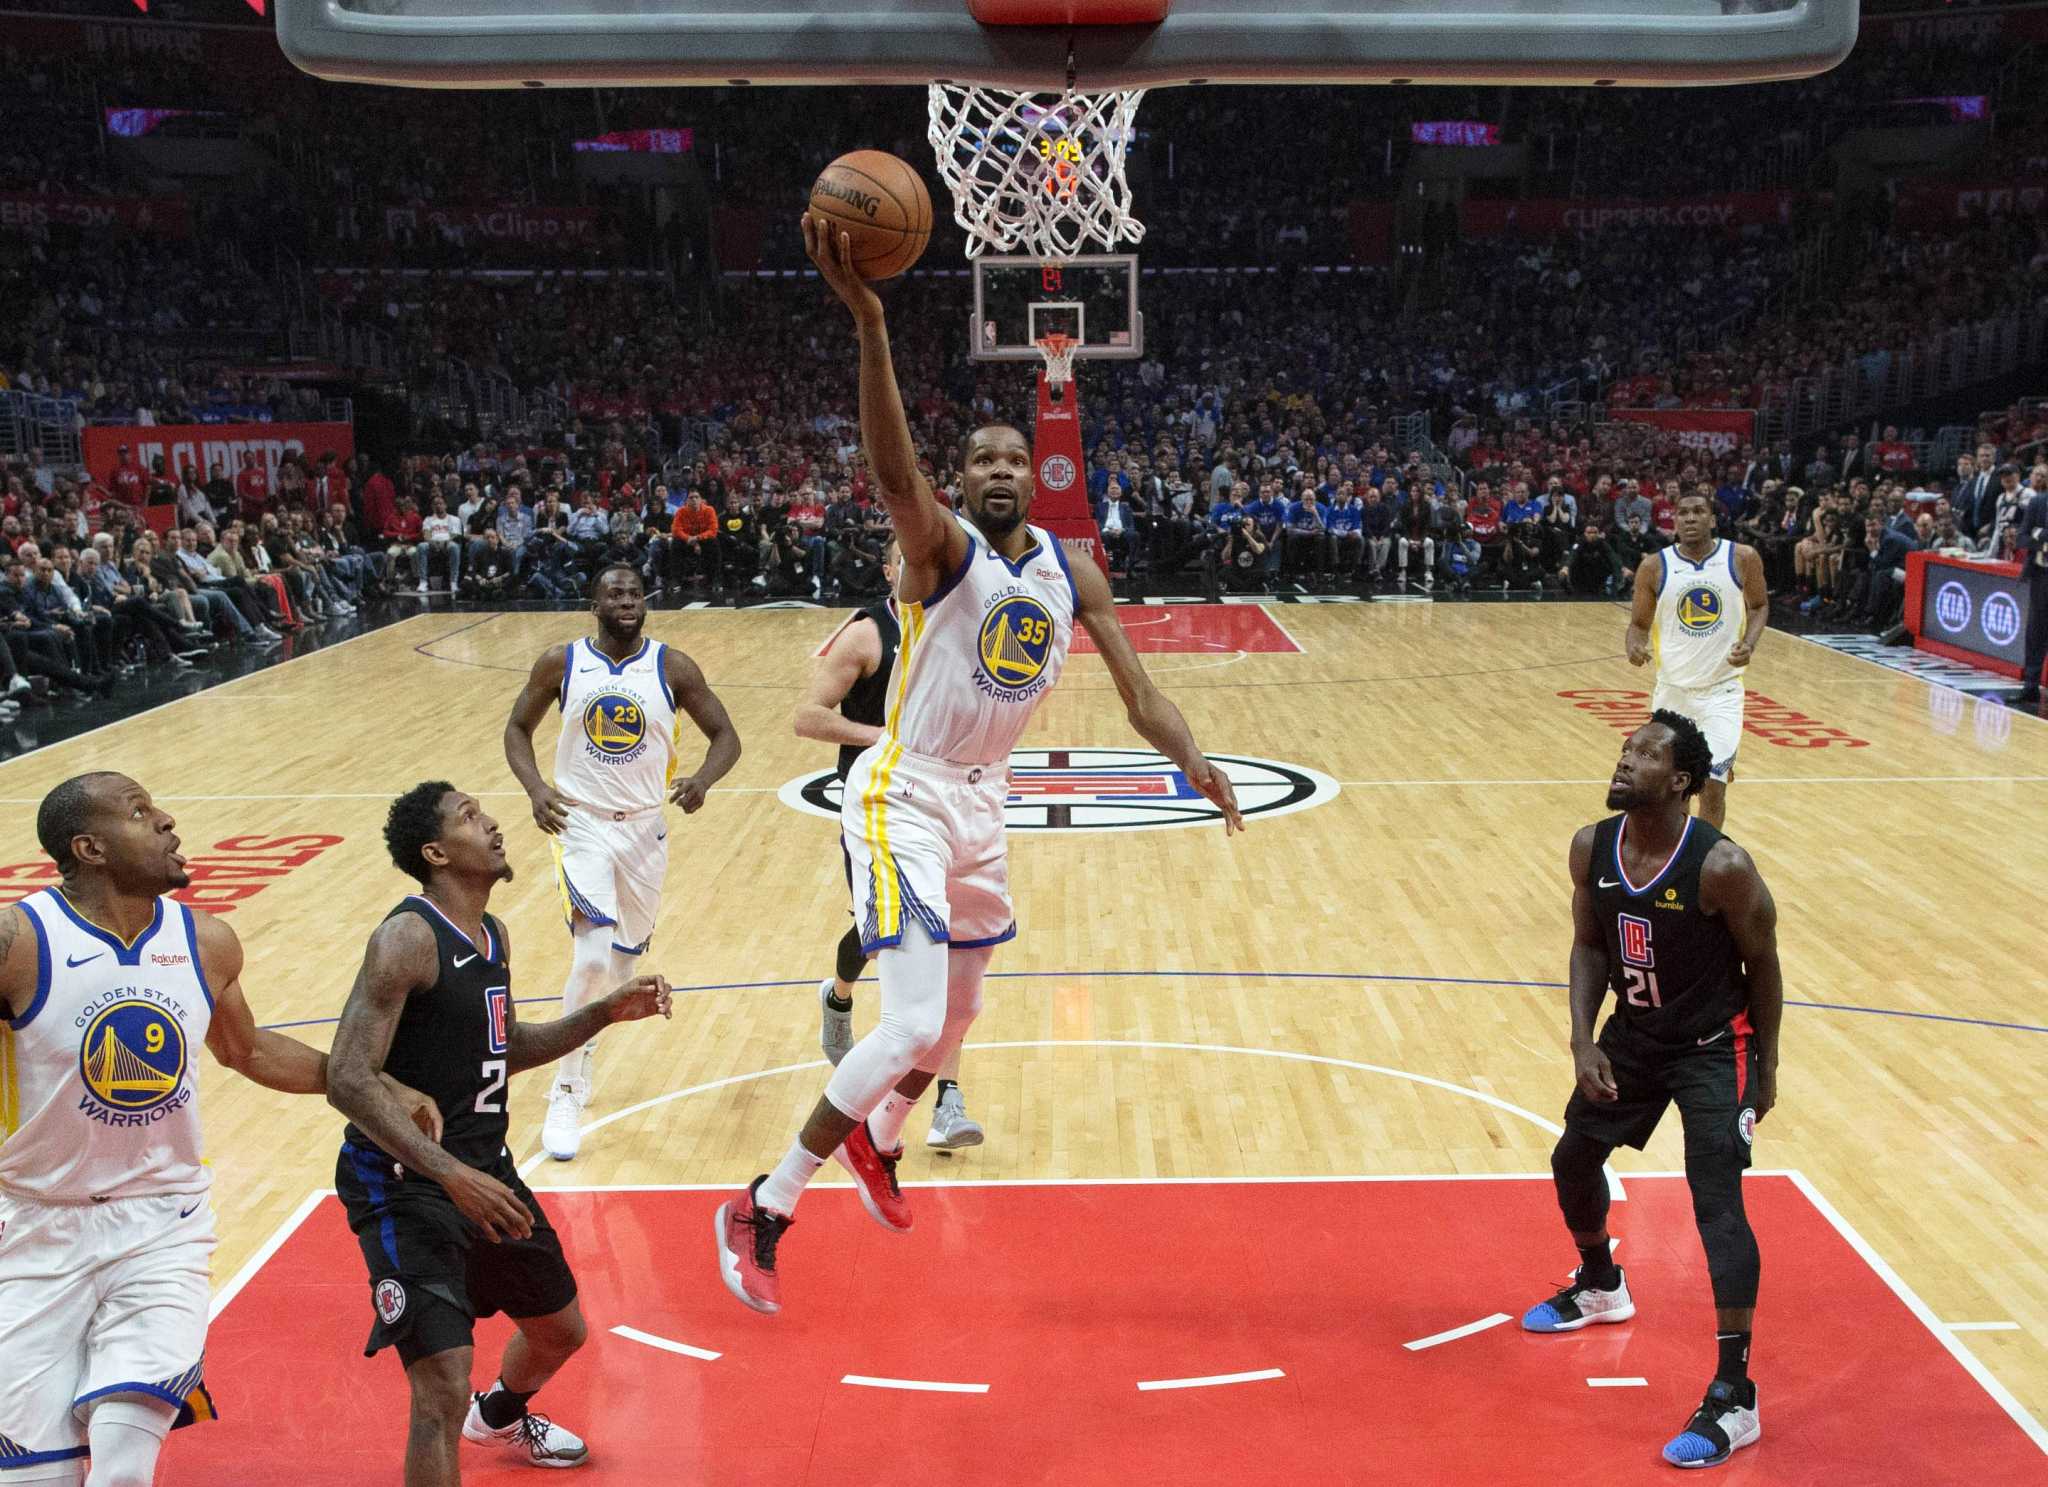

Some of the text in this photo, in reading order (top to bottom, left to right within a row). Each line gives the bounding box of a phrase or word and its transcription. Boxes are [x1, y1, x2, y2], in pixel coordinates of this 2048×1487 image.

[1701, 593, 1711, 607] 5
[1941, 591, 1965, 621] KIA
[1017, 617, 1048, 646] 35
[1987, 602, 2013, 635] KIA
[582, 685, 648, 704] GOLDEN STATE
[972, 666, 1047, 703] WARRIORS
[613, 705, 638, 723] 23
[585, 742, 648, 765] WARRIORS
[1655, 901, 1685, 912] bumble
[151, 953, 190, 965] Rakuten
[1623, 967, 1663, 1009] 21
[75, 987, 188, 1028] GOLDEN STATE
[145, 1023, 165, 1053] 9
[474, 1060, 508, 1113] 2
[77, 1087, 191, 1127] WARRIORS
